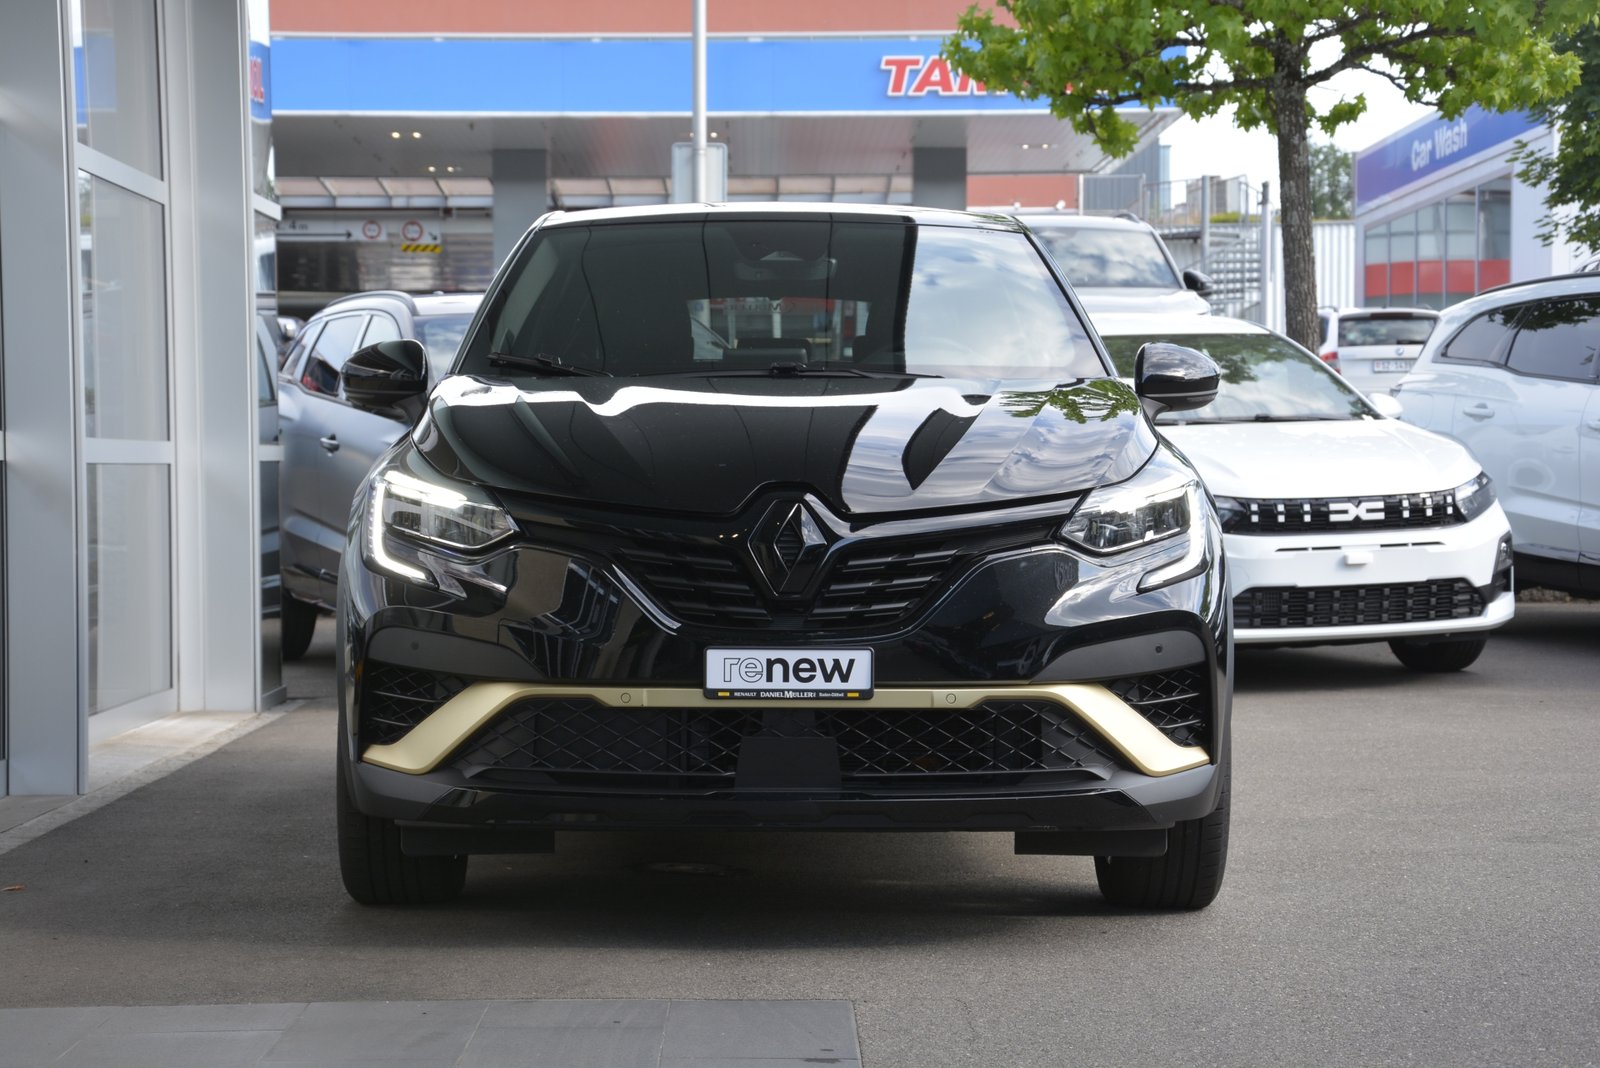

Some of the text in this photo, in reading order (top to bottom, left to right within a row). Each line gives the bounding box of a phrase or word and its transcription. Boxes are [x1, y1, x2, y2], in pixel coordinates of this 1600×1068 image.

[1411, 117, 1468, 171] Car Wash
[723, 657, 855, 683] renew
